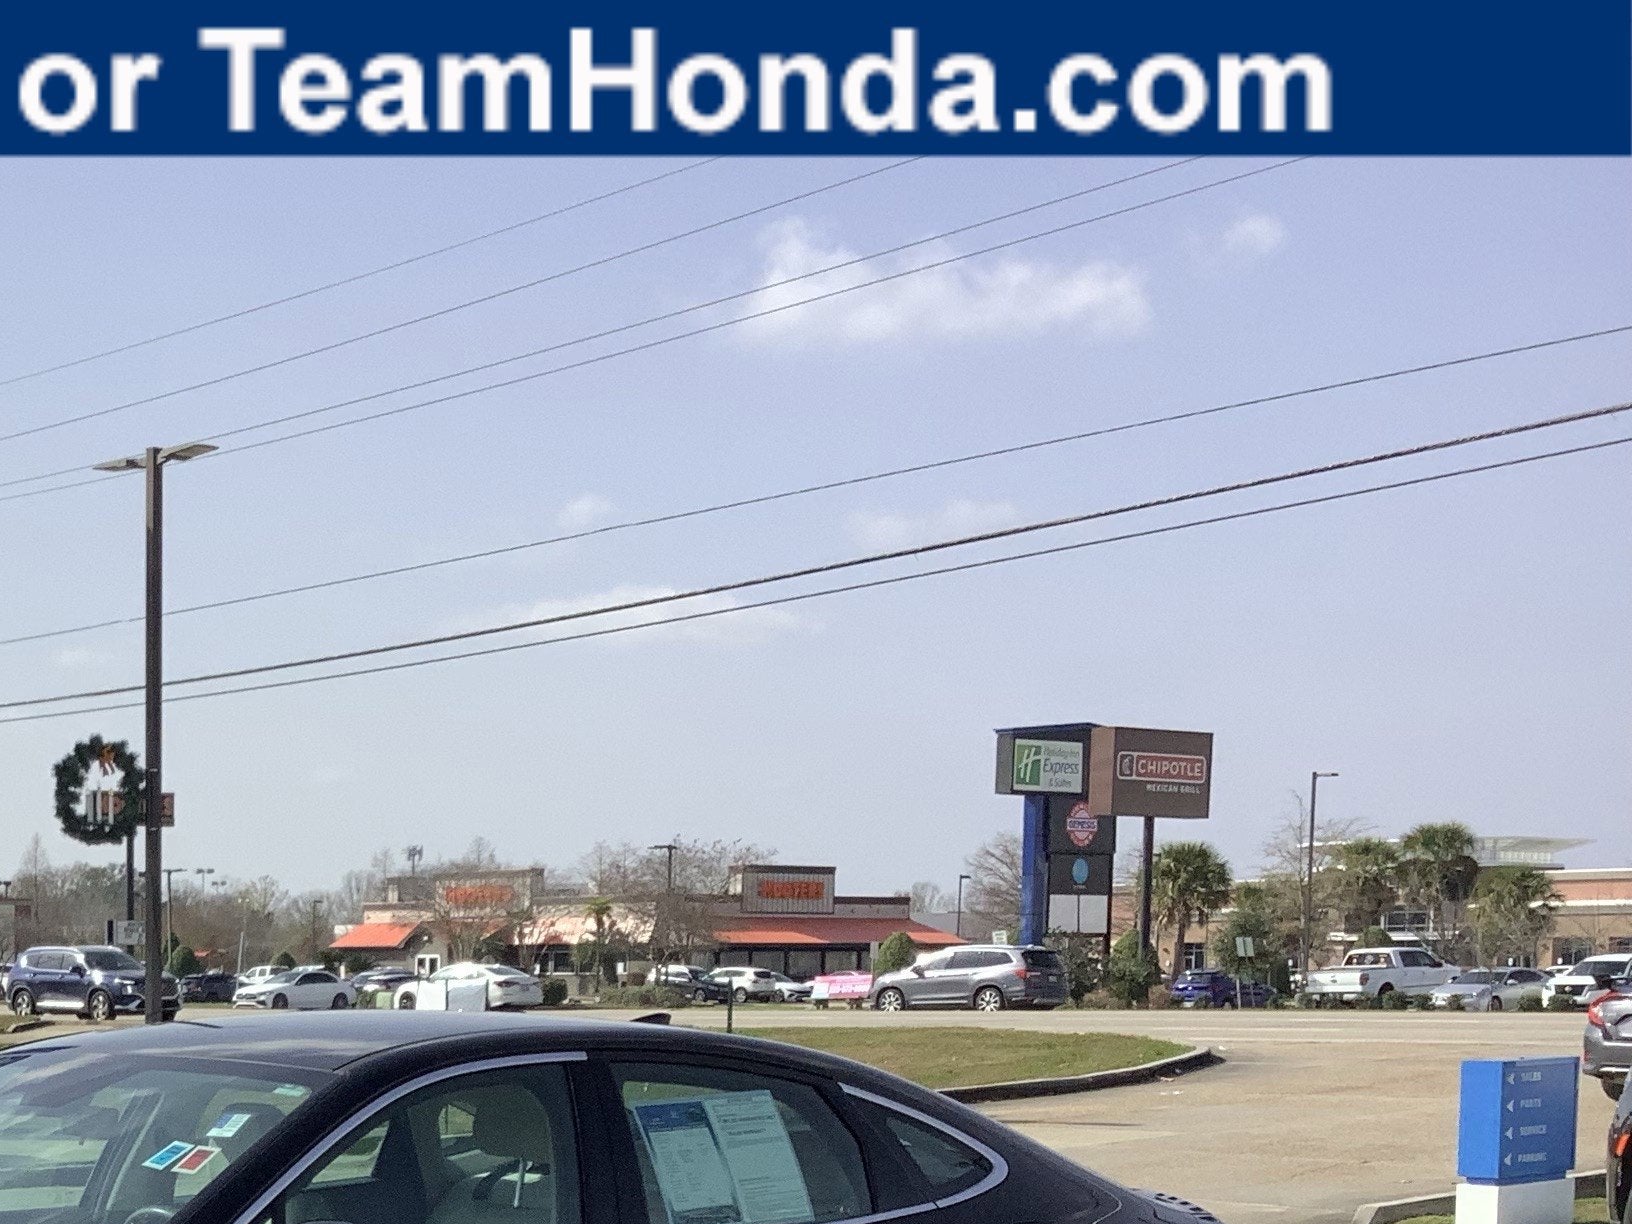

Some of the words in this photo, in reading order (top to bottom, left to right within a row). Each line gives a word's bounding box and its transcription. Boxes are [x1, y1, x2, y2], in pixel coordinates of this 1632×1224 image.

[1042, 758, 1079, 775] Express
[1137, 759, 1202, 777] CHIPOTLE
[1145, 783, 1179, 793] MEXICAN
